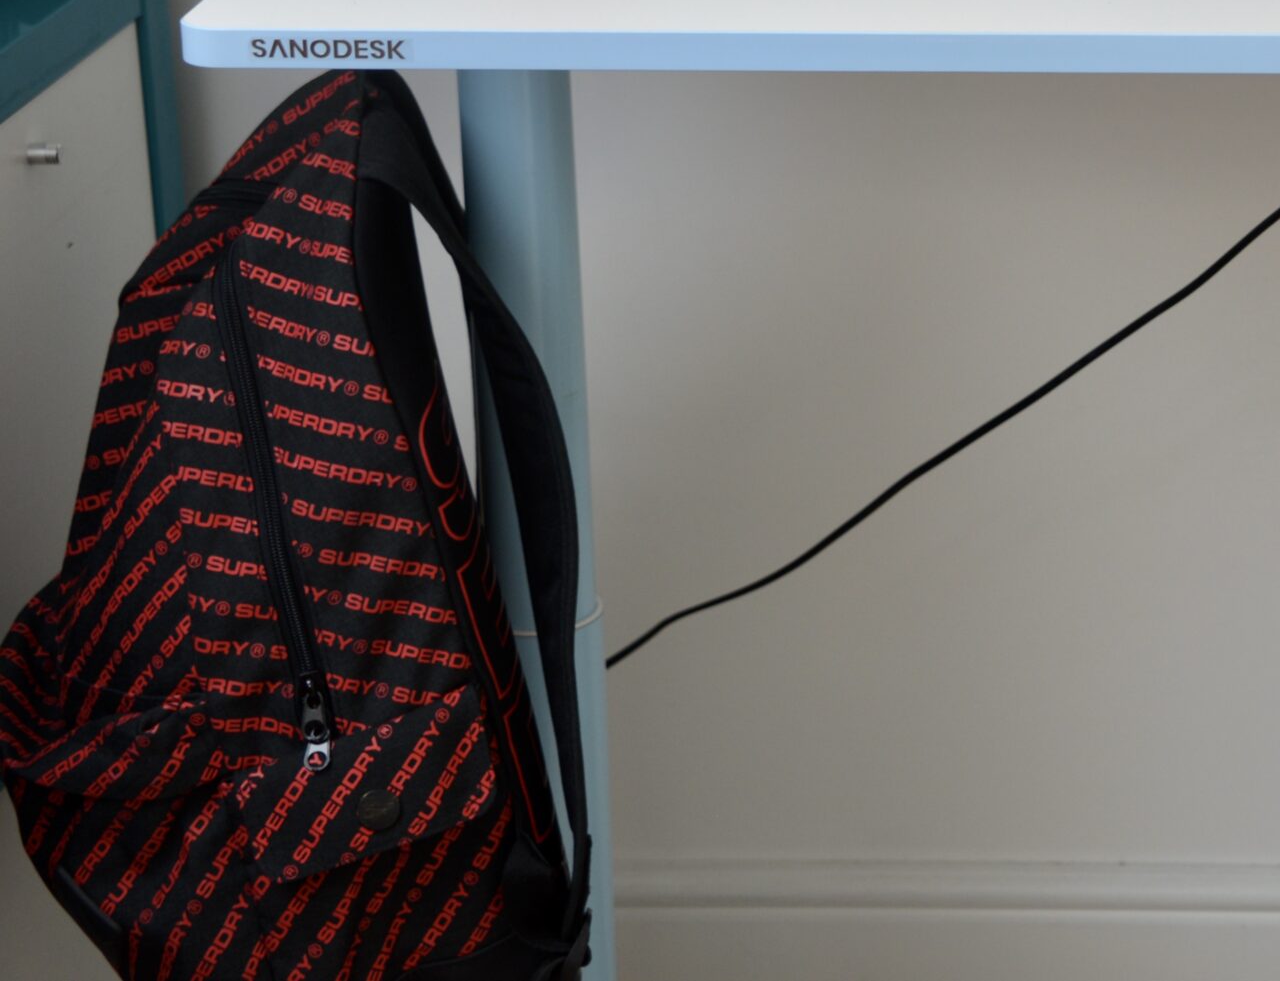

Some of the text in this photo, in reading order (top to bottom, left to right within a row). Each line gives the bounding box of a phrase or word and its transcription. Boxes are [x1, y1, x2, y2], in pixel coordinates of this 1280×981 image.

[250, 38, 406, 60] SANODESK
[313, 285, 364, 311] SUP
[291, 499, 435, 538] SUPERDRY
[293, 724, 393, 864] SUPERDRY®
